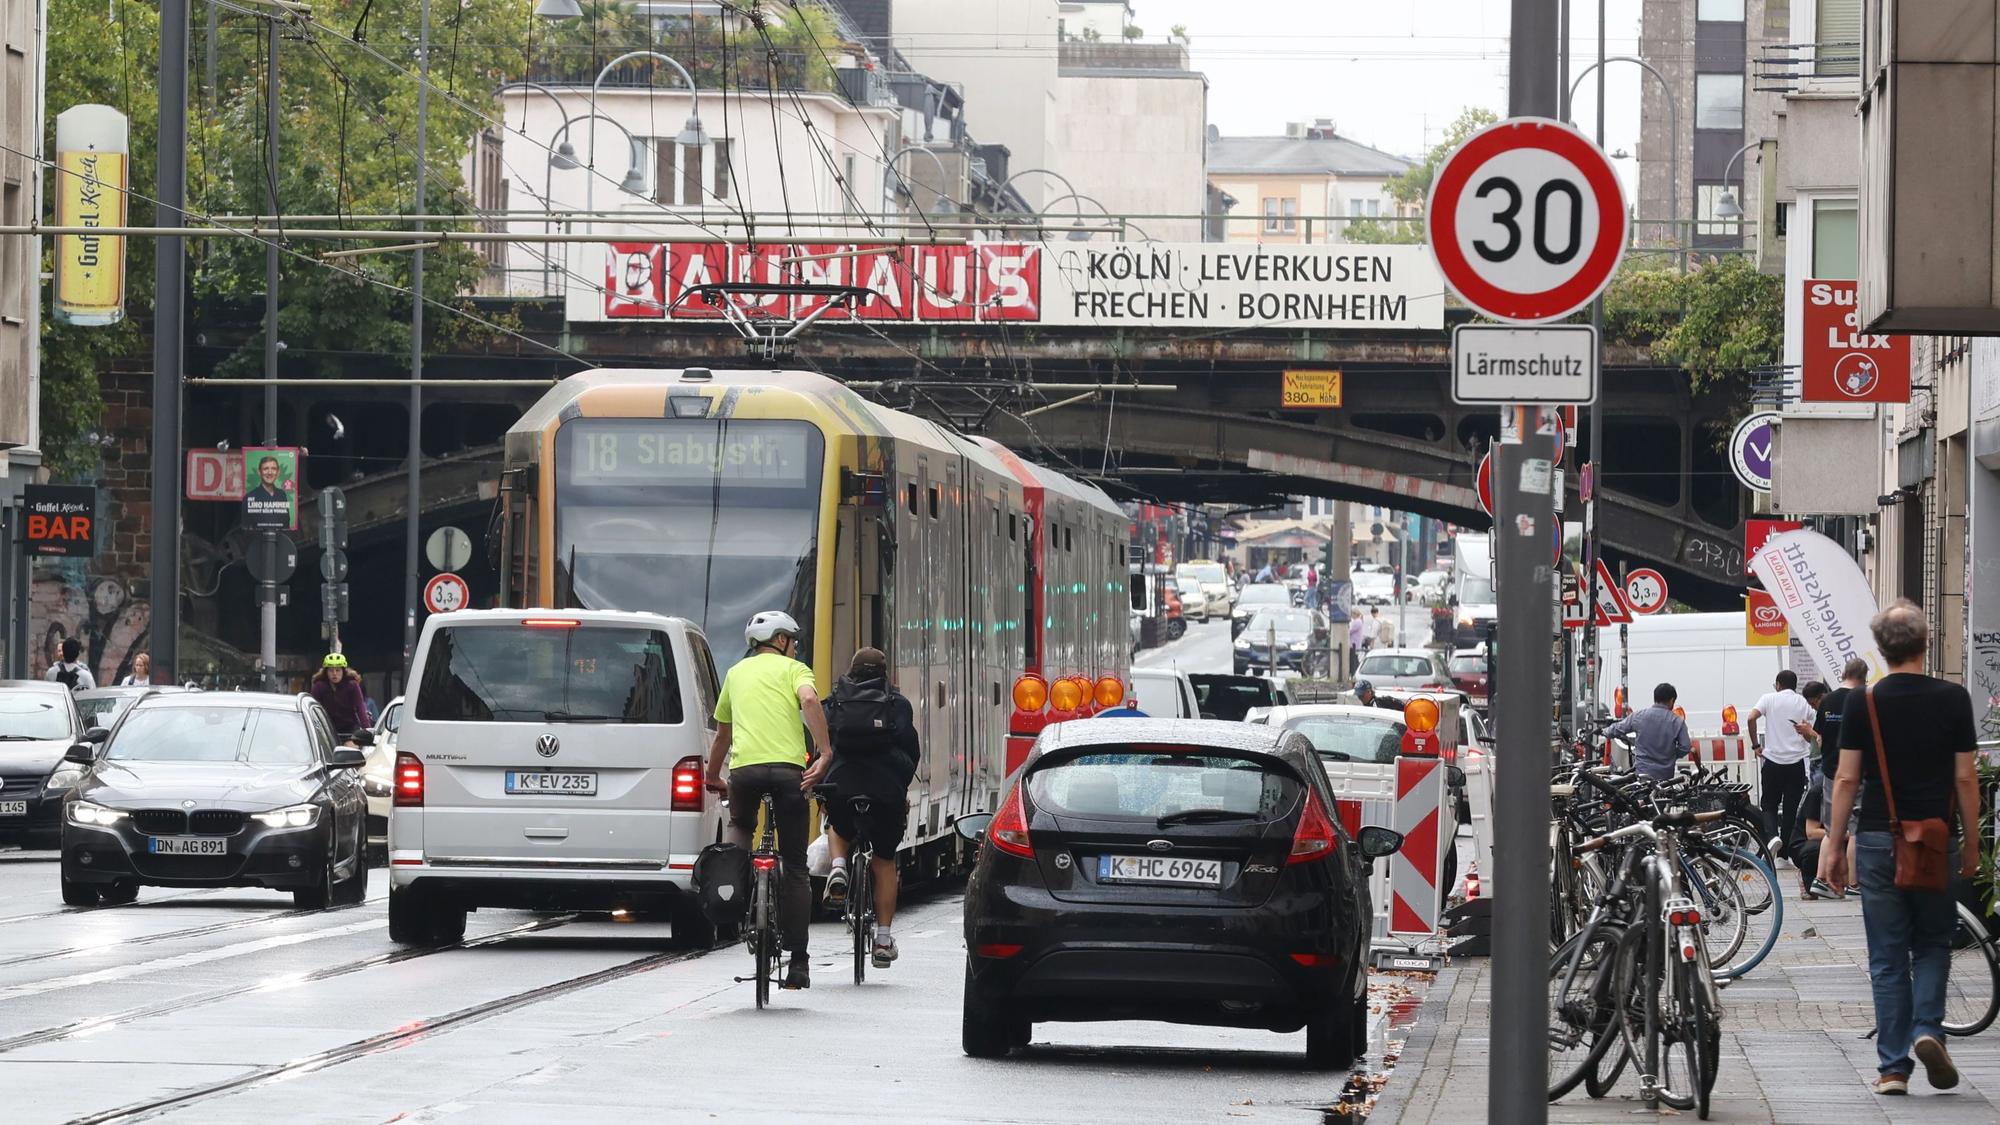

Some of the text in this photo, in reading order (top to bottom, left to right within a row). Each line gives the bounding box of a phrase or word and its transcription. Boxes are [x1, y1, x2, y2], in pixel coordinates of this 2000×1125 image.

[1472, 176, 1583, 265] 30
[78, 213, 100, 267] Gafel
[1090, 247, 1170, 280] KÖLN
[1201, 254, 1391, 282] LEVERKUSEN
[614, 253, 1031, 307] BAUHAUS
[1074, 291, 1406, 321] FRECHEN BORNHEIM
[1810, 284, 1858, 306] Su
[1829, 327, 1891, 349] Lux
[1467, 352, 1582, 377] Lärmschutz
[586, 432, 788, 473] 18 Slabystr.
[28, 515, 90, 541] BAR
[520, 774, 590, 789] K EV 235
[157, 838, 225, 854] DN AG 891
[1112, 858, 1218, 881] K HC 6964
